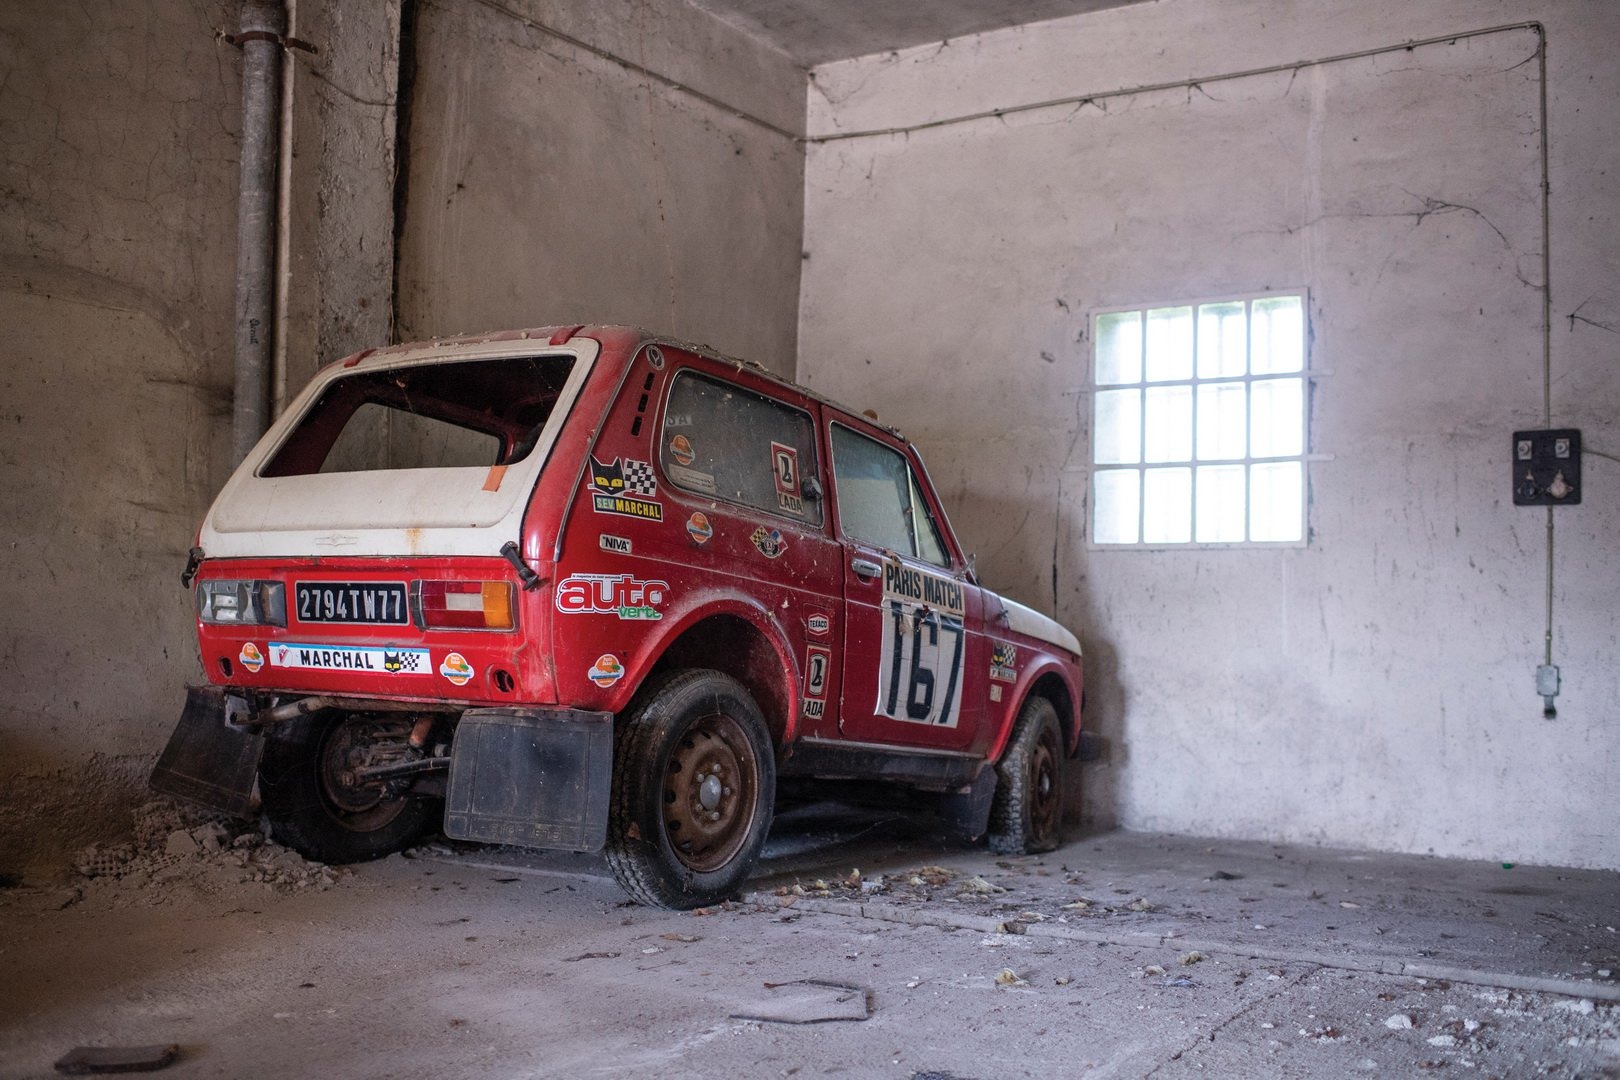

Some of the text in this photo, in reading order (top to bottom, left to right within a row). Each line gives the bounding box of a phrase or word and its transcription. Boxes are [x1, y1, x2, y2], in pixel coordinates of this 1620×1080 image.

[615, 498, 661, 518] MARCHAL
[778, 493, 803, 512] LADA
[557, 574, 671, 614] auto
[885, 562, 963, 611] PARIS MATCH
[809, 620, 828, 628] TEXACO
[300, 649, 374, 669] MARCHAL
[886, 601, 964, 724] 167
[803, 701, 823, 717] ADA
